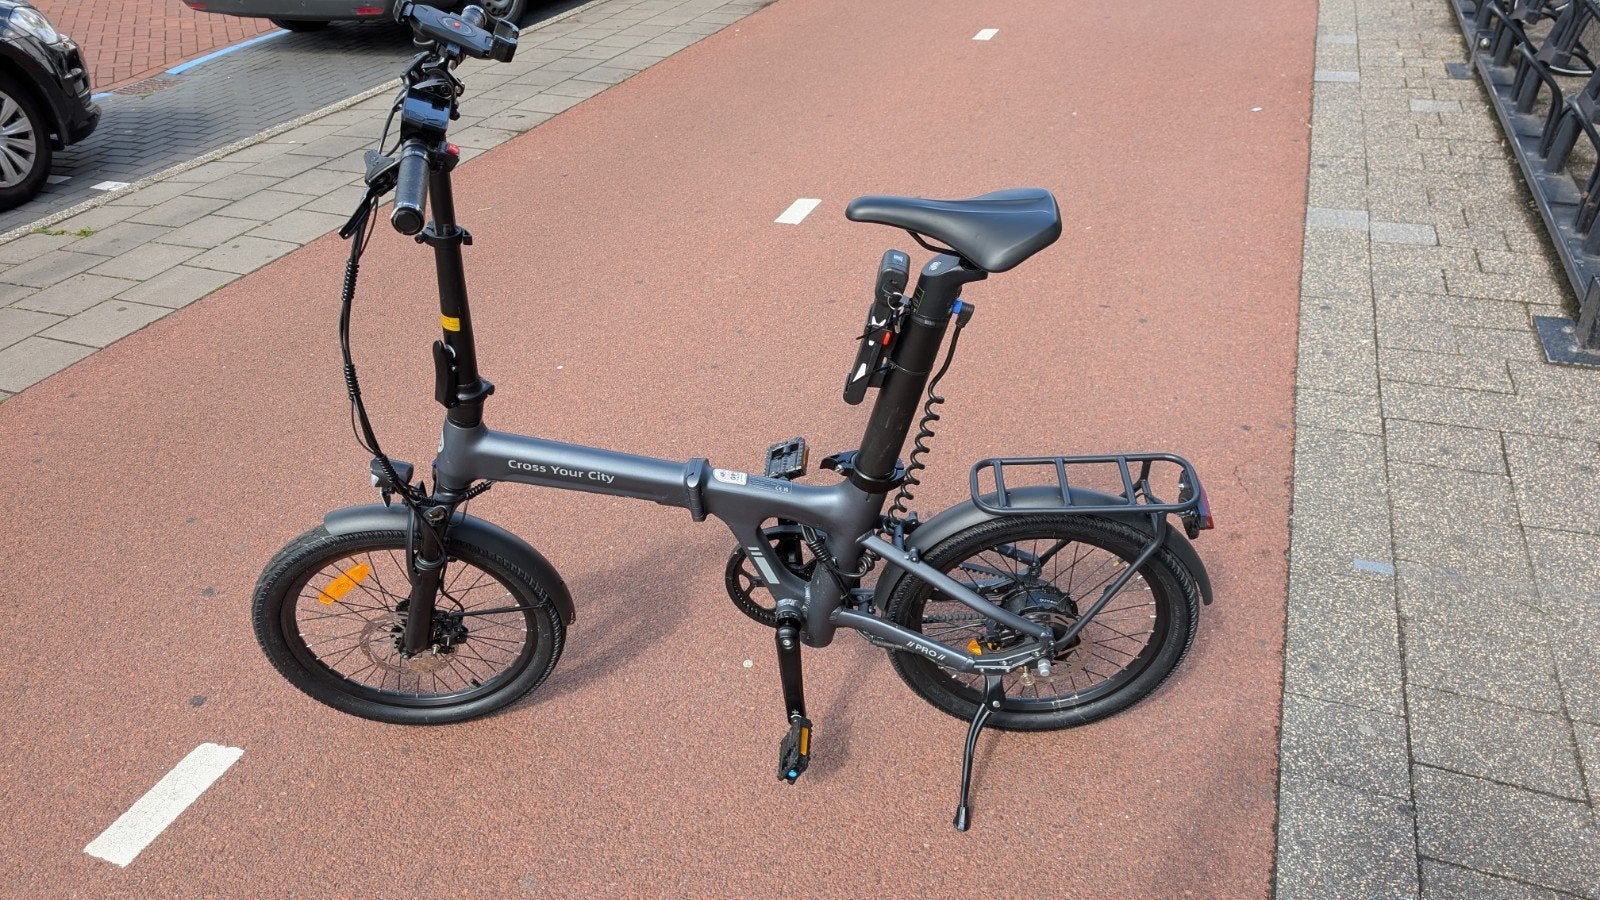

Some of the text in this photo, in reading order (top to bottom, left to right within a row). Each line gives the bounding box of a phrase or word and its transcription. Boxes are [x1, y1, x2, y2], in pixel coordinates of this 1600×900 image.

[508, 459, 615, 484] Cross Your City
